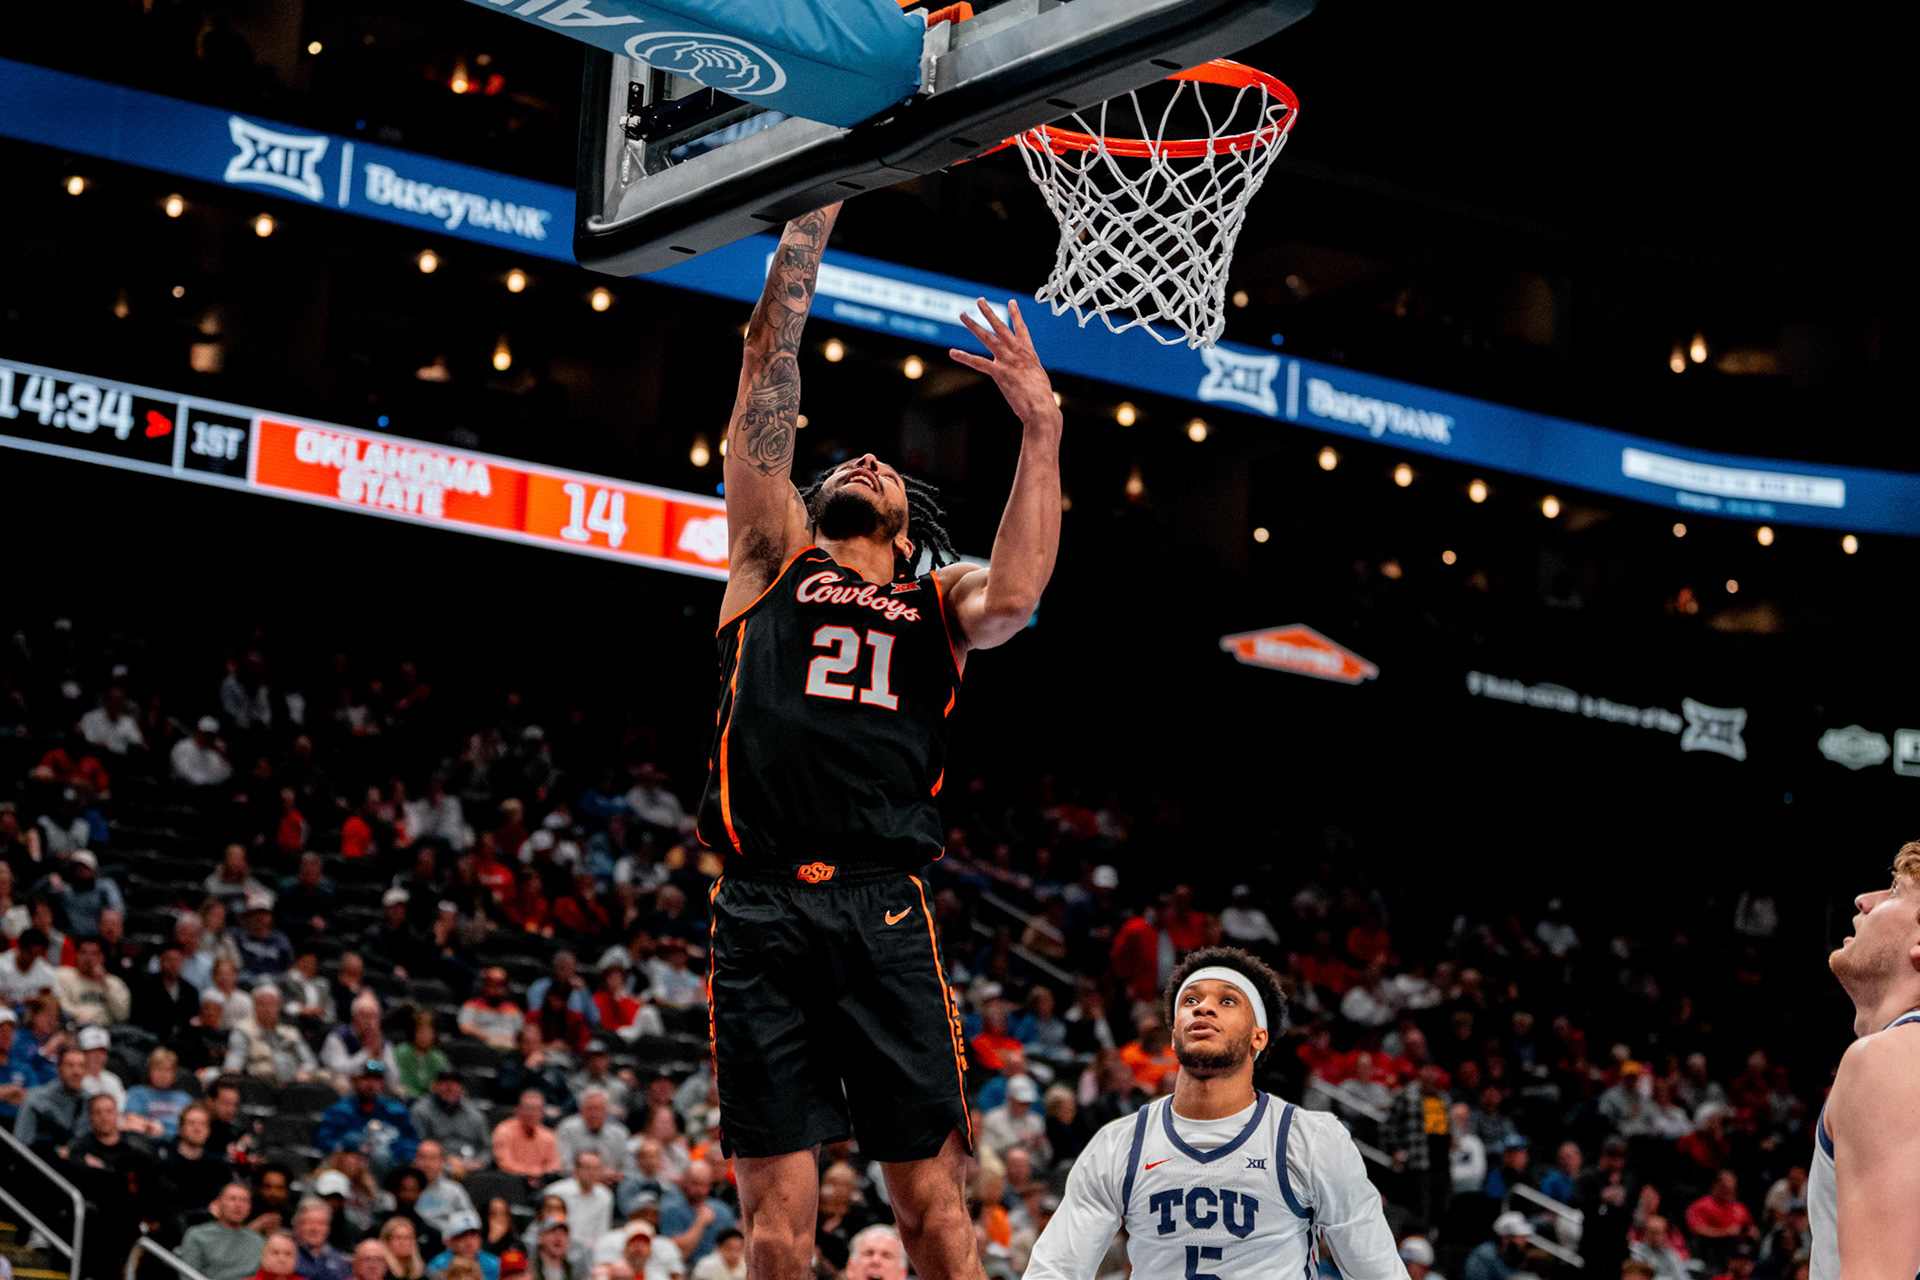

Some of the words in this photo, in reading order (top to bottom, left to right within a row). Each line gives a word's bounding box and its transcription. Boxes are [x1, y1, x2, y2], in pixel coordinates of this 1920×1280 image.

[0, 366, 134, 440] 14:34
[191, 421, 245, 461] 1ST
[295, 430, 491, 497] OKLAHOMA
[338, 468, 445, 517] STATE
[560, 482, 627, 547] 14
[796, 570, 921, 622] Cowboys
[805, 624, 899, 711] 21
[797, 862, 836, 884] OSU
[1246, 1157, 1267, 1170] XII
[1150, 1187, 1259, 1239] TCU
